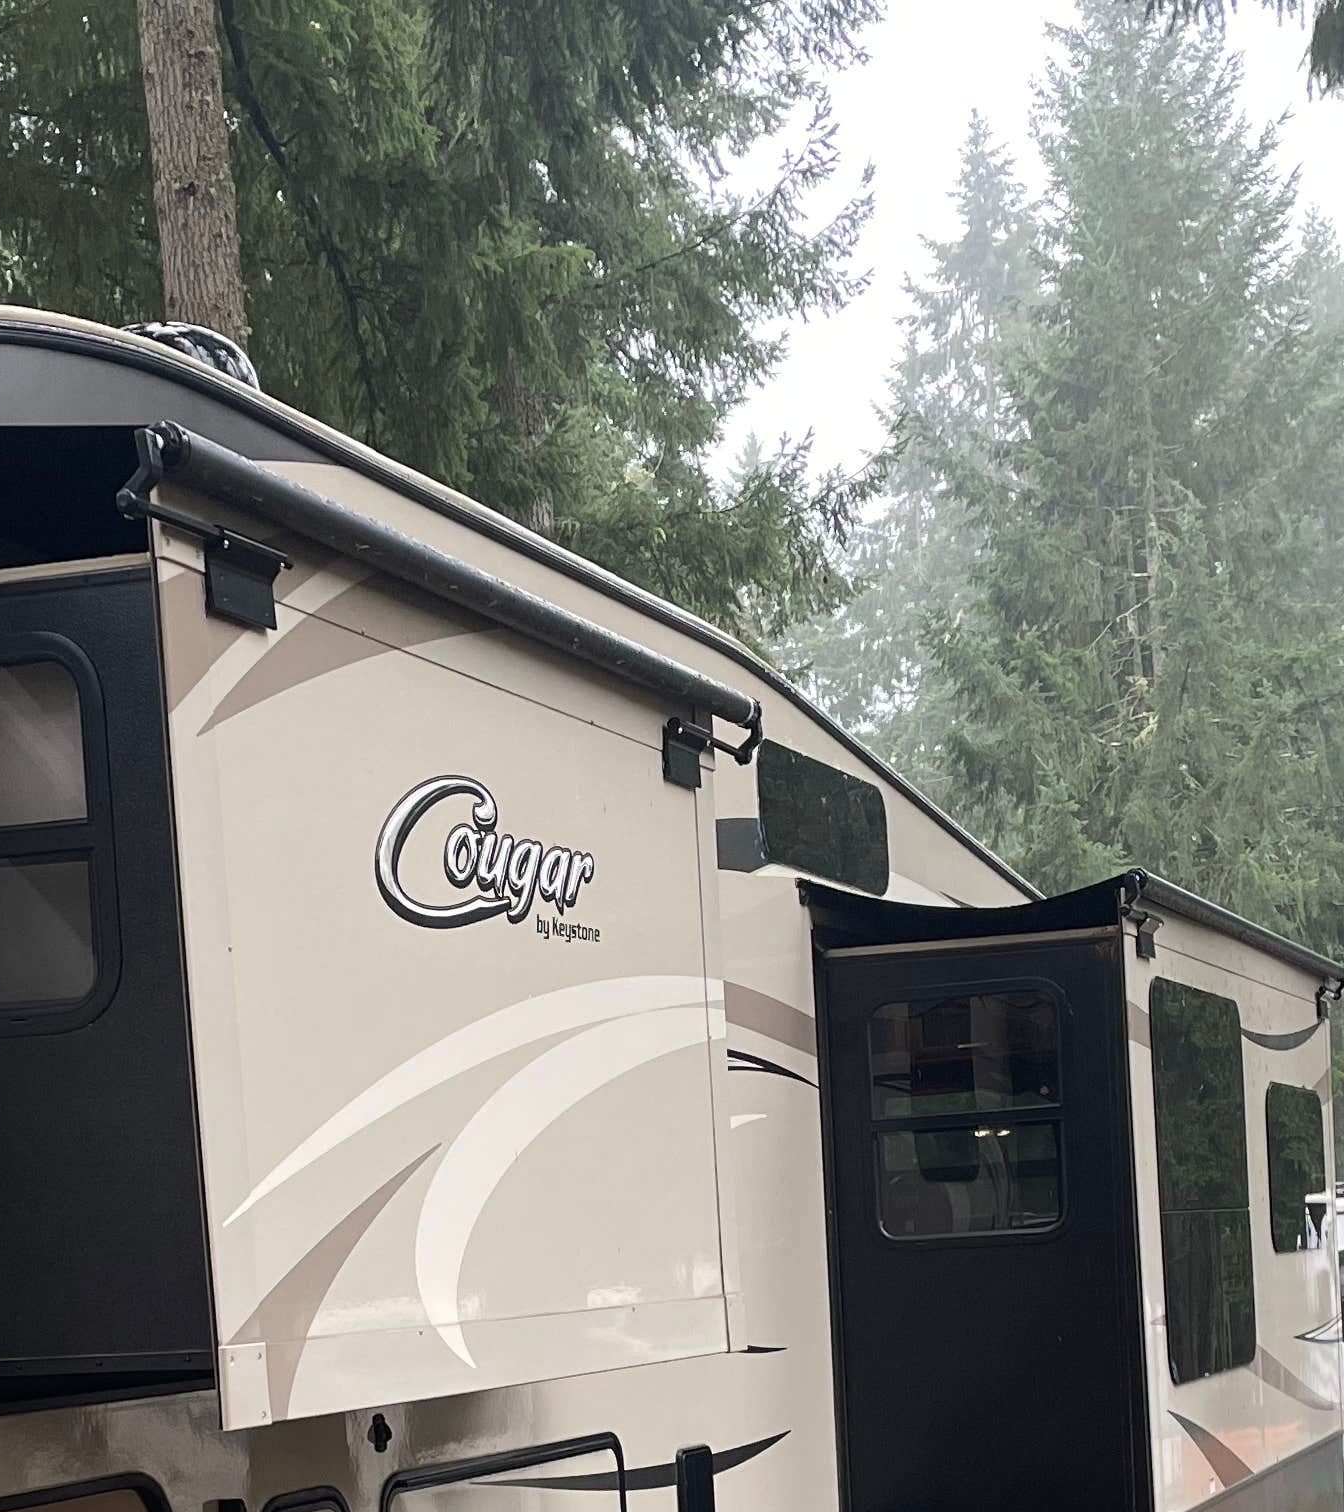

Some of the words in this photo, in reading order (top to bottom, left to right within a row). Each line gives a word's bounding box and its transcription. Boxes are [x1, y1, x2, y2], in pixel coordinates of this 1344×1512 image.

[375, 774, 594, 929] Cougar
[536, 914, 550, 940] by
[552, 916, 601, 943] Keystone
